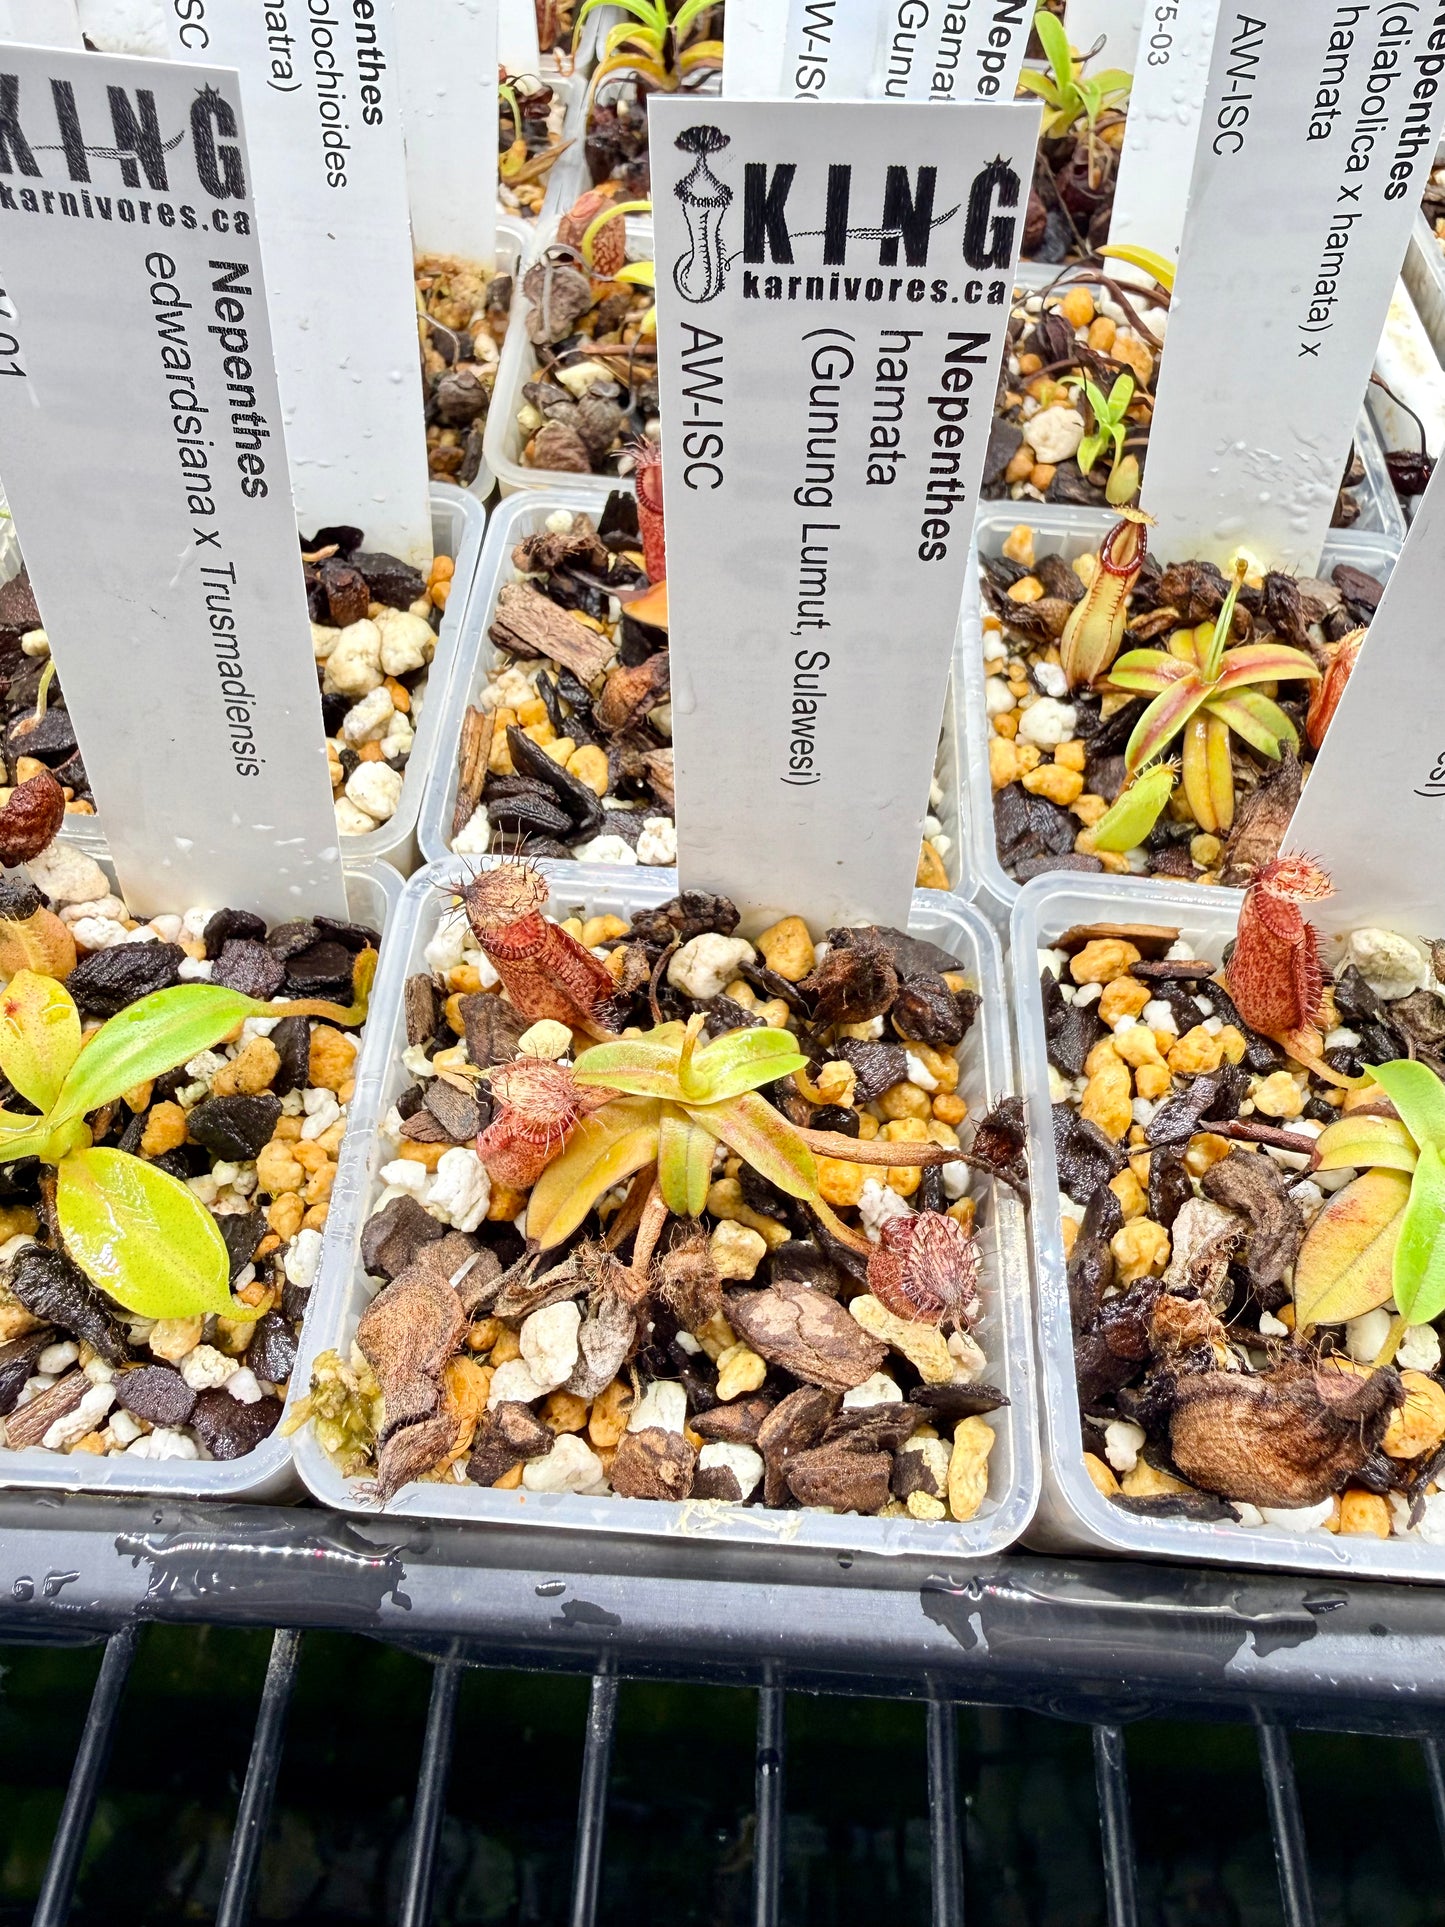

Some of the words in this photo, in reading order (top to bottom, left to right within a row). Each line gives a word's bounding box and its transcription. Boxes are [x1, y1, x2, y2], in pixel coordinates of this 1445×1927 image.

[1147, 0, 1179, 66] 5-03
[1212, 13, 1267, 156] AW-ISC
[1306, 5, 1370, 142] hamata
[1344, 2, 1419, 174] (diabolica
[0, 74, 247, 200] KING
[1337, 184, 1363, 203] x
[743, 154, 1021, 271] KING
[1298, 213, 1363, 333] hamata)
[742, 271, 1006, 305] karnivores.ca
[1298, 342, 1322, 357] x
[145, 251, 216, 516] edwardsiana
[208, 260, 270, 499] Nepenthes
[680, 322, 724, 490] AW-ISC
[794, 328, 855, 507] (Gunung
[865, 330, 923, 486] hamata
[918, 331, 991, 562] Nepenthes
[192, 527, 223, 549] x
[790, 524, 840, 636] Lumut,
[200, 561, 265, 777] Trusmadiensis
[780, 649, 831, 786] Sulawesi)
